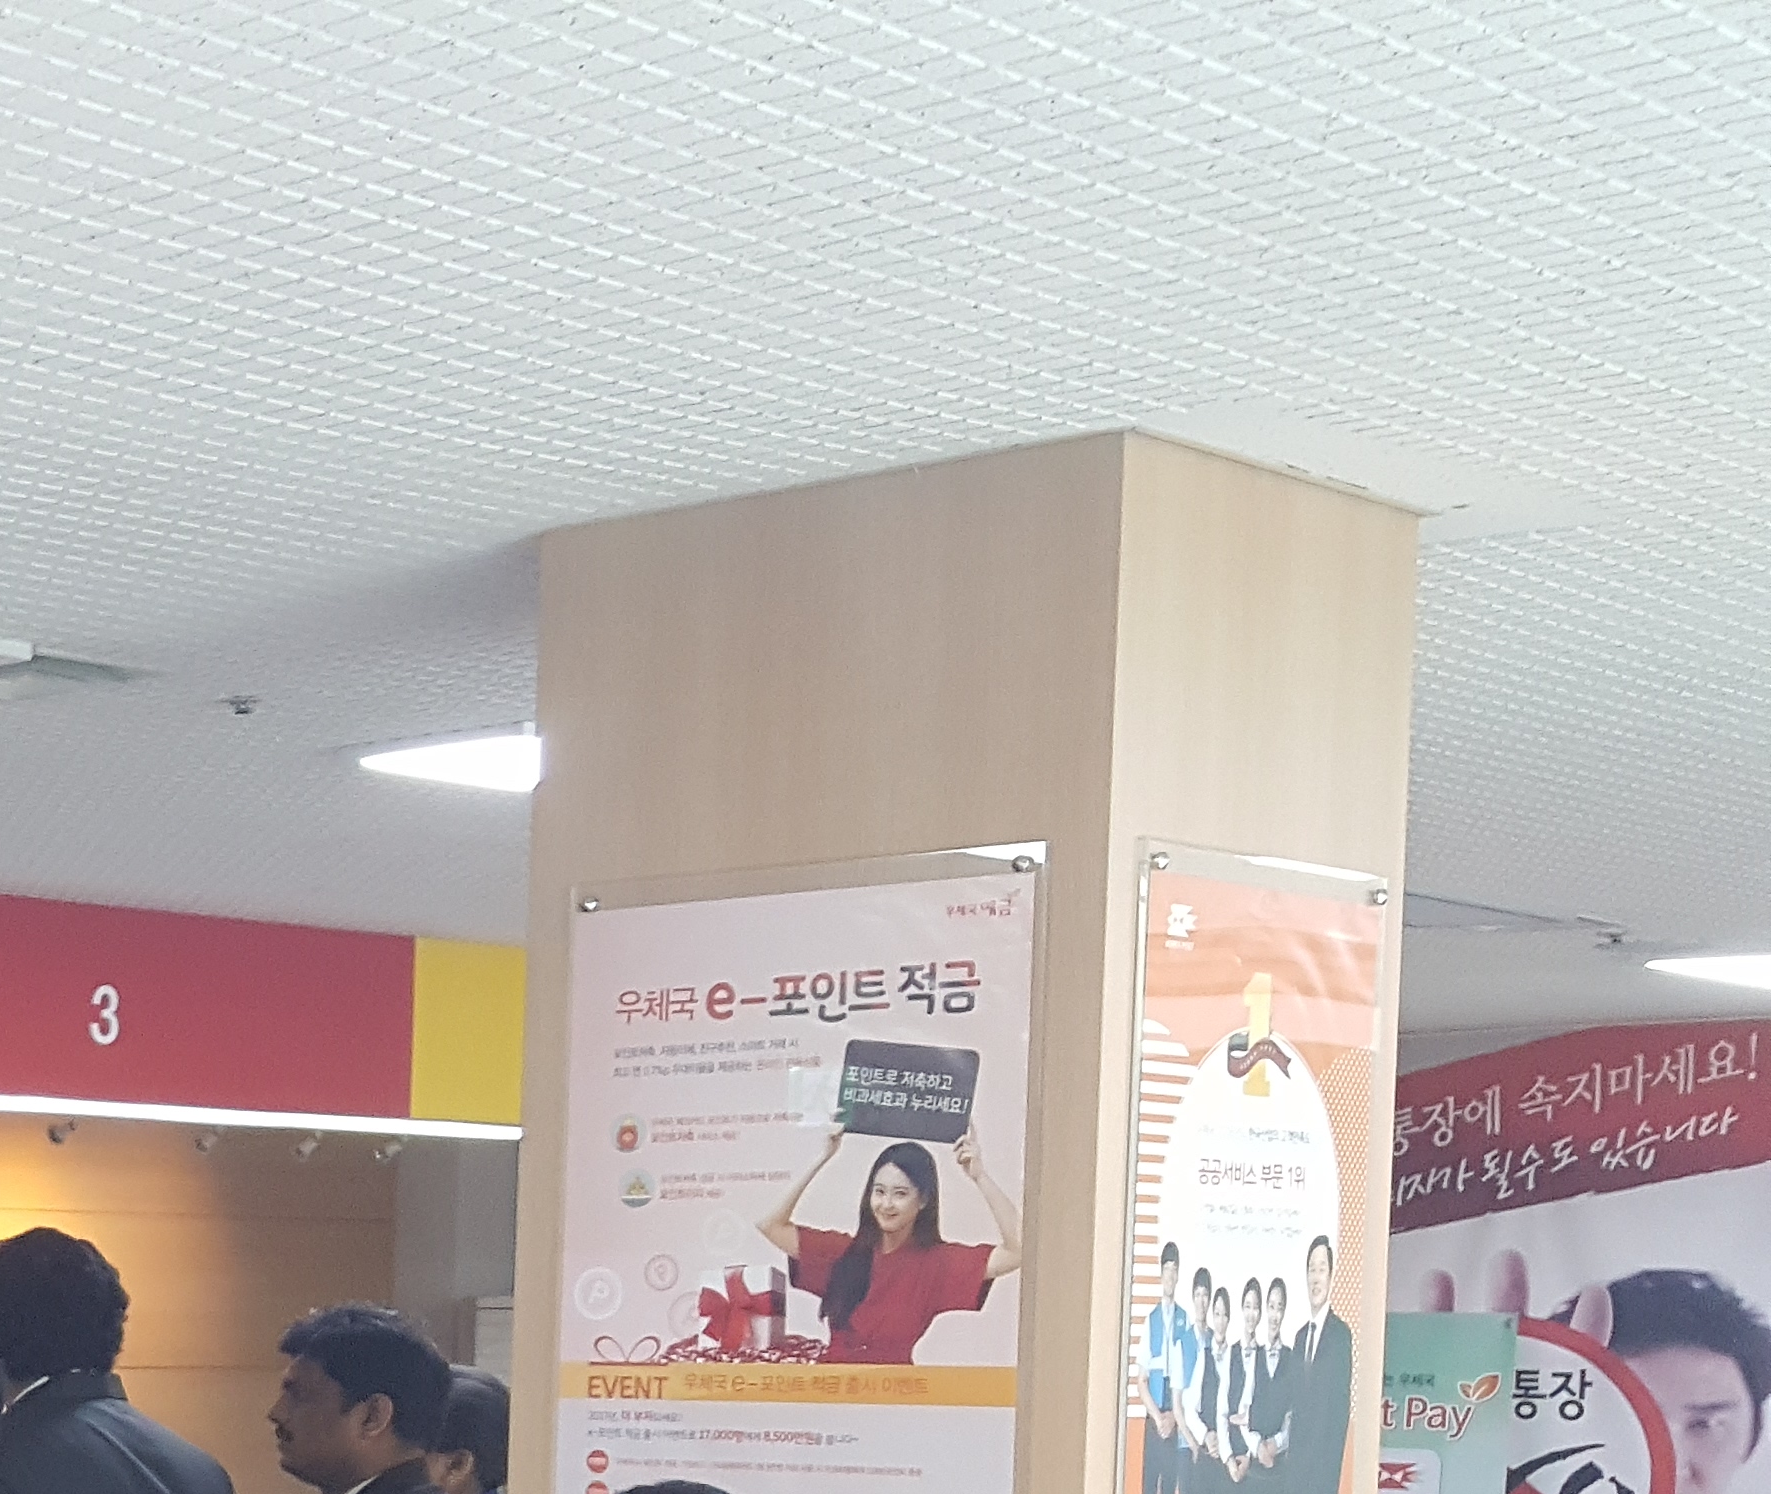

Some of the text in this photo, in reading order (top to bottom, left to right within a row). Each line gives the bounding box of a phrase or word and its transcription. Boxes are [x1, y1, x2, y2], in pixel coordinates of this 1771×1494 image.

[88, 984, 121, 1046] 3
[615, 960, 981, 1025] 우체국 e-포인트 적금
[846, 1066, 953, 1091] 포인트로 저축하고
[1518, 1032, 1759, 1121] 속지마세요!
[843, 1087, 969, 1115] 비과세효과 누리세요!
[1198, 1158, 1306, 1193] 공공서비스 부문 1위
[1391, 1159, 1473, 1206] 자가
[1590, 1106, 1740, 1171] 있습니다
[587, 1375, 668, 1399] EVENT
[684, 1373, 726, 1393] 우체국
[812, 1374, 841, 1394] 적금
[881, 1376, 929, 1395] 이벤트
[1512, 1367, 1593, 1421] 통장
[1406, 1397, 1473, 1439] Pay
